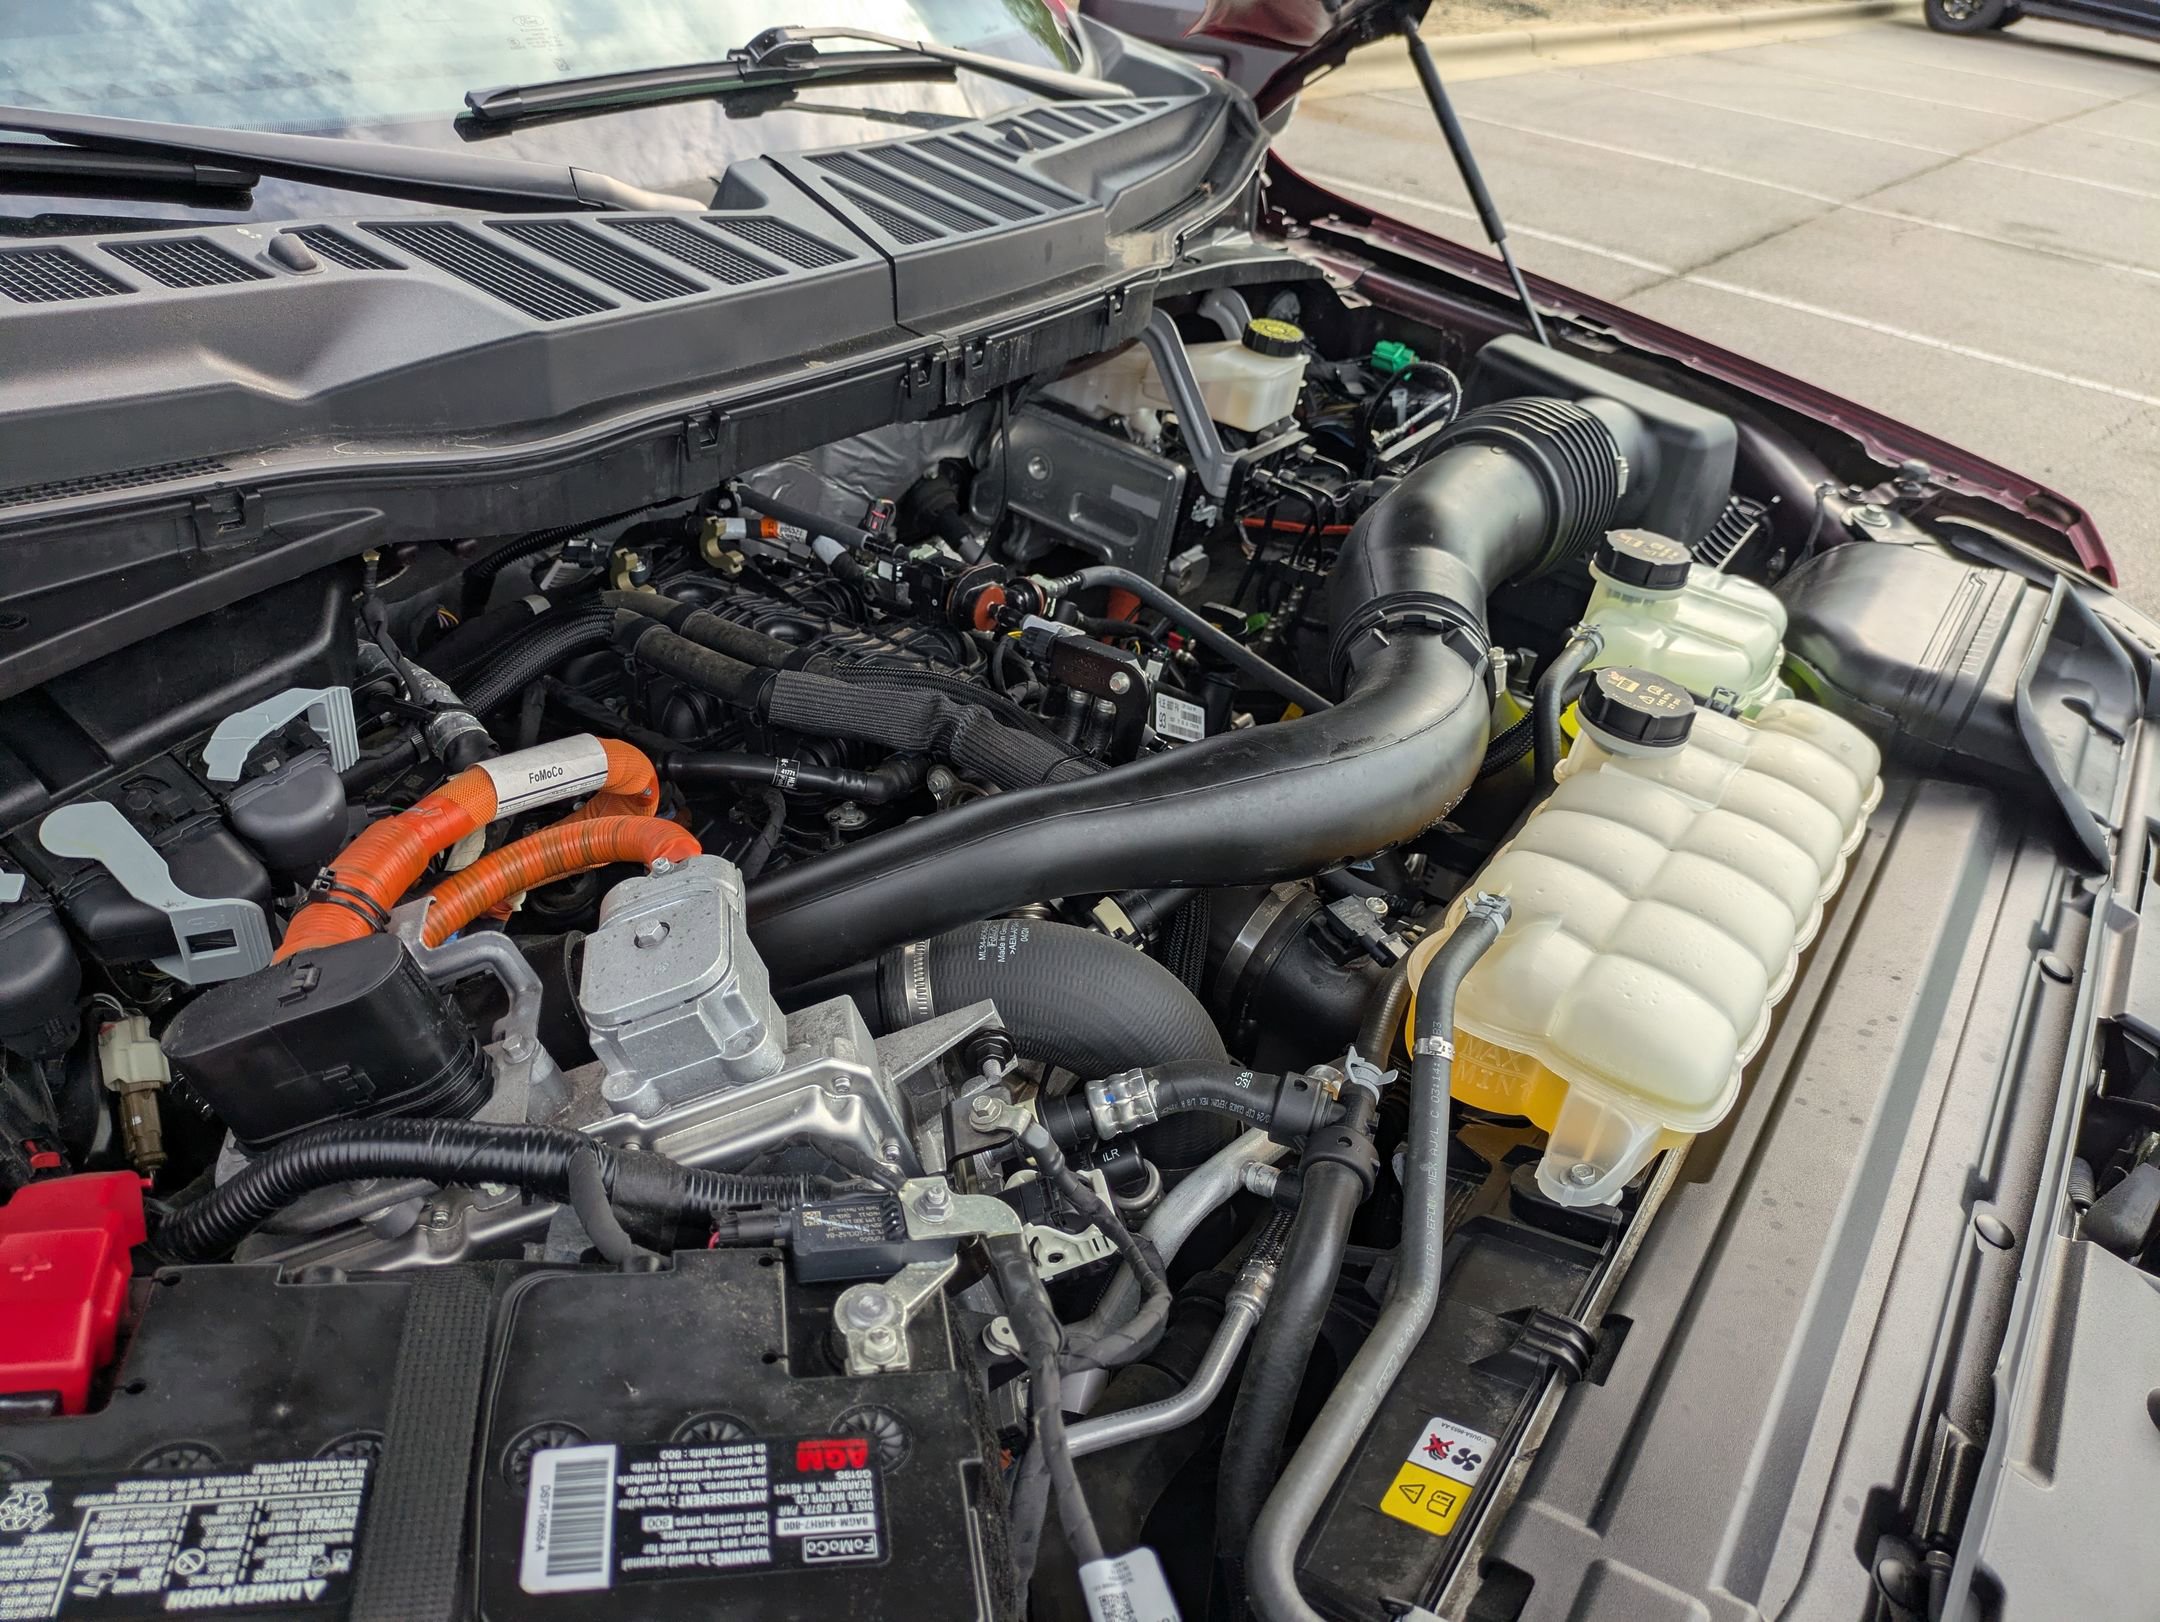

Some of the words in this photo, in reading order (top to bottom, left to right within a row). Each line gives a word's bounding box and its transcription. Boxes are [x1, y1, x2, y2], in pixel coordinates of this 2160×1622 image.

[527, 764, 564, 783] FoMoCo
[996, 942, 1007, 962] Made
[1462, 1036, 1523, 1071] MAX
[1240, 1071, 1253, 1079] UP
[1457, 1064, 1512, 1097] MIN
[1234, 1076, 1250, 1088] ISC
[1101, 1147, 1120, 1162] ILR
[1426, 1161, 1438, 1185] MEX
[688, 1446, 722, 1458] volants
[753, 1442, 766, 1453] de
[667, 1458, 703, 1470] secours
[754, 1454, 766, 1464] de
[795, 1445, 869, 1472] AGM
[640, 1482, 667, 1495] guide
[680, 1481, 700, 1492] Voir
[700, 1478, 748, 1491] blessures.
[750, 1477, 766, 1488] des
[773, 1482, 801, 1494] 48121
[803, 1482, 816, 1492] MI
[818, 1478, 872, 1492] DEARBORN,
[624, 1485, 639, 1496] du
[846, 1489, 873, 1501] FORD
[646, 1495, 669, 1508] Pour
[676, 1488, 767, 1507] AVERTISSEMENT
[791, 1493, 809, 1504] CO.
[810, 1491, 844, 1503] MOTOR
[777, 1504, 798, 1516] PAR
[833, 1501, 847, 1512] BY
[849, 1500, 873, 1512] DIST.
[674, 1514, 701, 1527] amps
[702, 1510, 744, 1525] cranking
[745, 1510, 768, 1522] Cold
[647, 1517, 669, 1528] 800
[743, 1522, 768, 1535] jump
[657, 1526, 718, 1541] instructions.
[718, 1525, 742, 1536] start
[641, 1543, 658, 1554] for
[658, 1540, 687, 1553] guide
[688, 1539, 719, 1551] owner
[720, 1537, 739, 1549] see
[806, 1537, 874, 1556] FoMoCo
[620, 1554, 666, 1570] personal
[667, 1553, 695, 1567] avoid
[695, 1552, 709, 1566] To
[709, 1548, 770, 1565] WARNING:
[163, 1580, 304, 1608] DANGER/POISON
